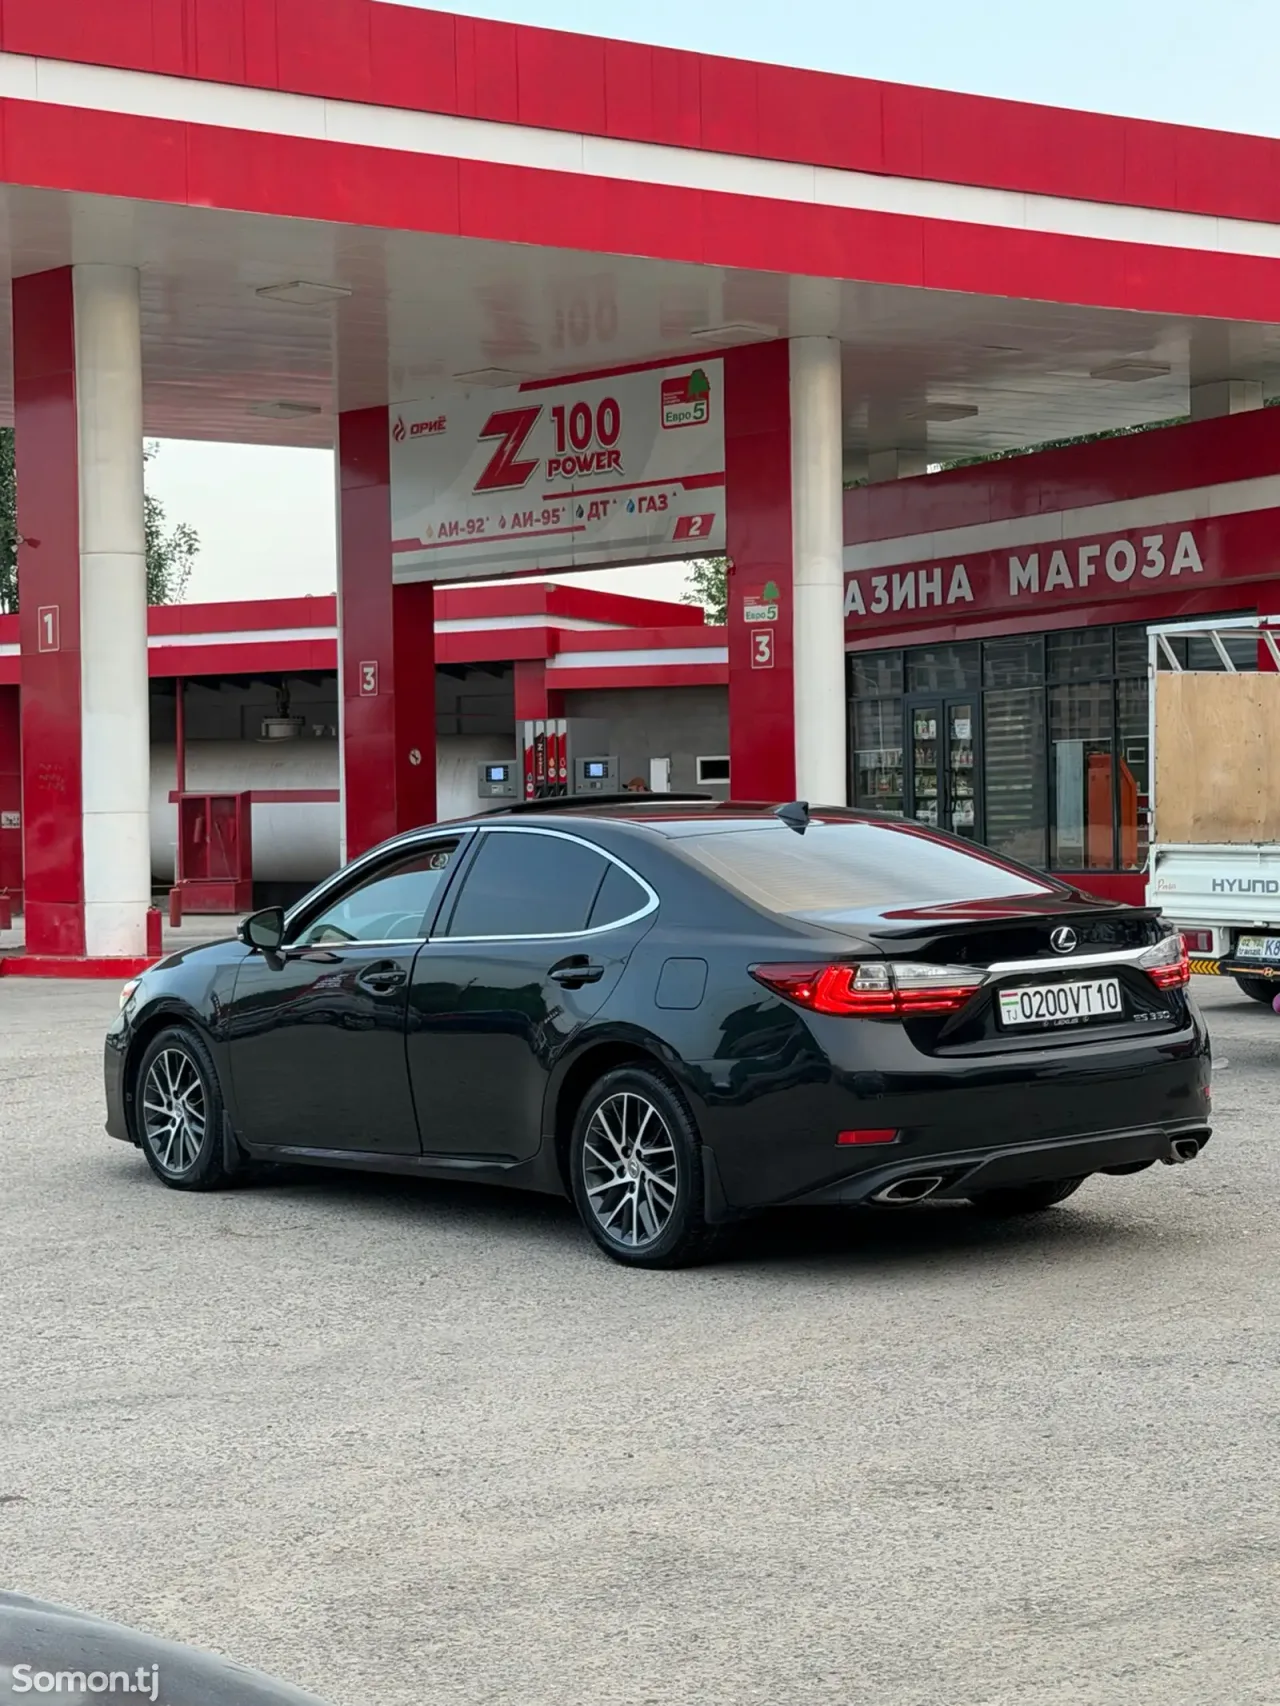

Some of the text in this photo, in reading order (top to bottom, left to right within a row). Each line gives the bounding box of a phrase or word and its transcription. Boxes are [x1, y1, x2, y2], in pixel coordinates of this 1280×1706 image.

[666, 401, 705, 423] Евро 5
[473, 397, 621, 493] Z 100
[546, 450, 624, 480] POWER
[438, 493, 668, 538] АИ-92 АИ-95 ДТ ГАЗ
[688, 516, 702, 537] 2
[843, 564, 975, 618] АЗИНА
[745, 605, 776, 620] Евро 5
[43, 613, 53, 644] 1
[754, 635, 770, 662] 3
[363, 666, 375, 691] 3
[1211, 878, 1280, 893] HYUND
[1006, 1009, 1018, 1021] TJ
